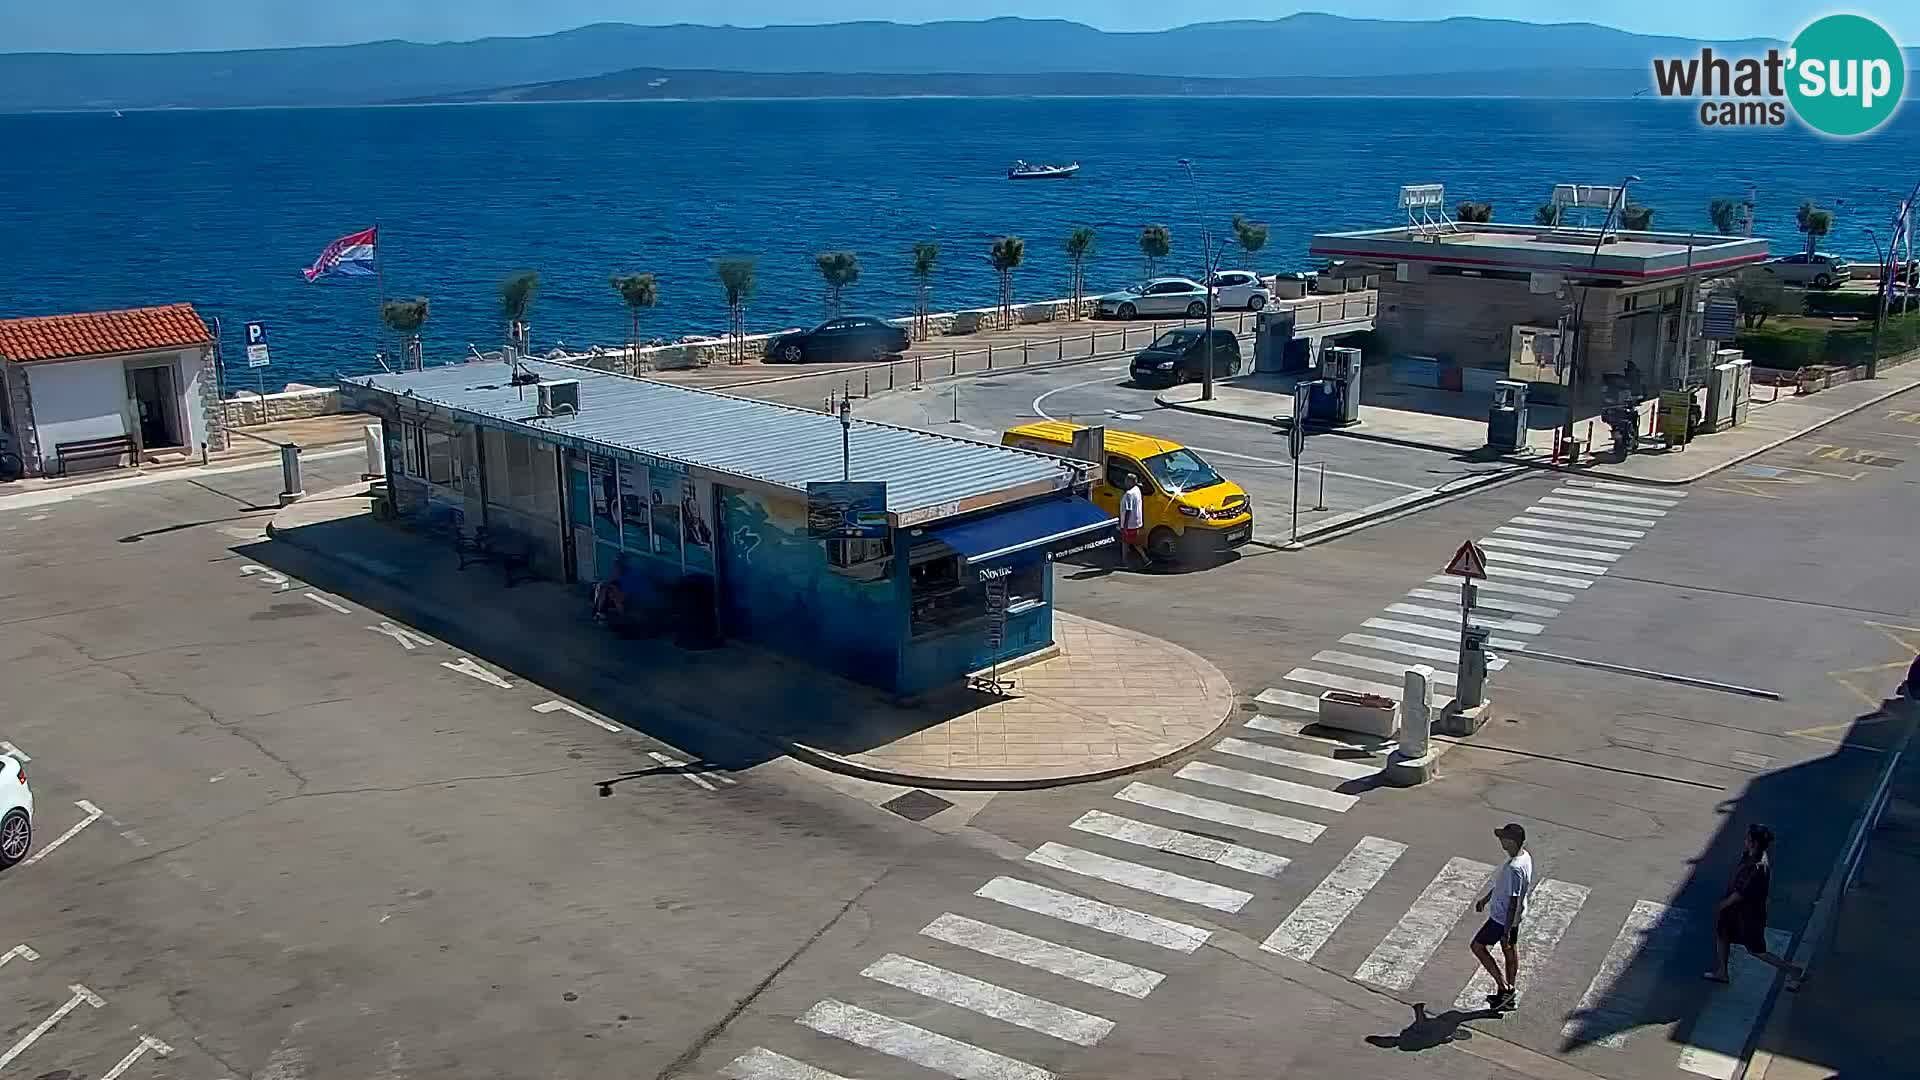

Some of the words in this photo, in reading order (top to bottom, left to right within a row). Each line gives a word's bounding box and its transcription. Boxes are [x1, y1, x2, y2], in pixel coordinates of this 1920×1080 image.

[249, 325, 261, 343] P
[632, 454, 658, 468] TICKET
[659, 459, 687, 473] OFFICE
